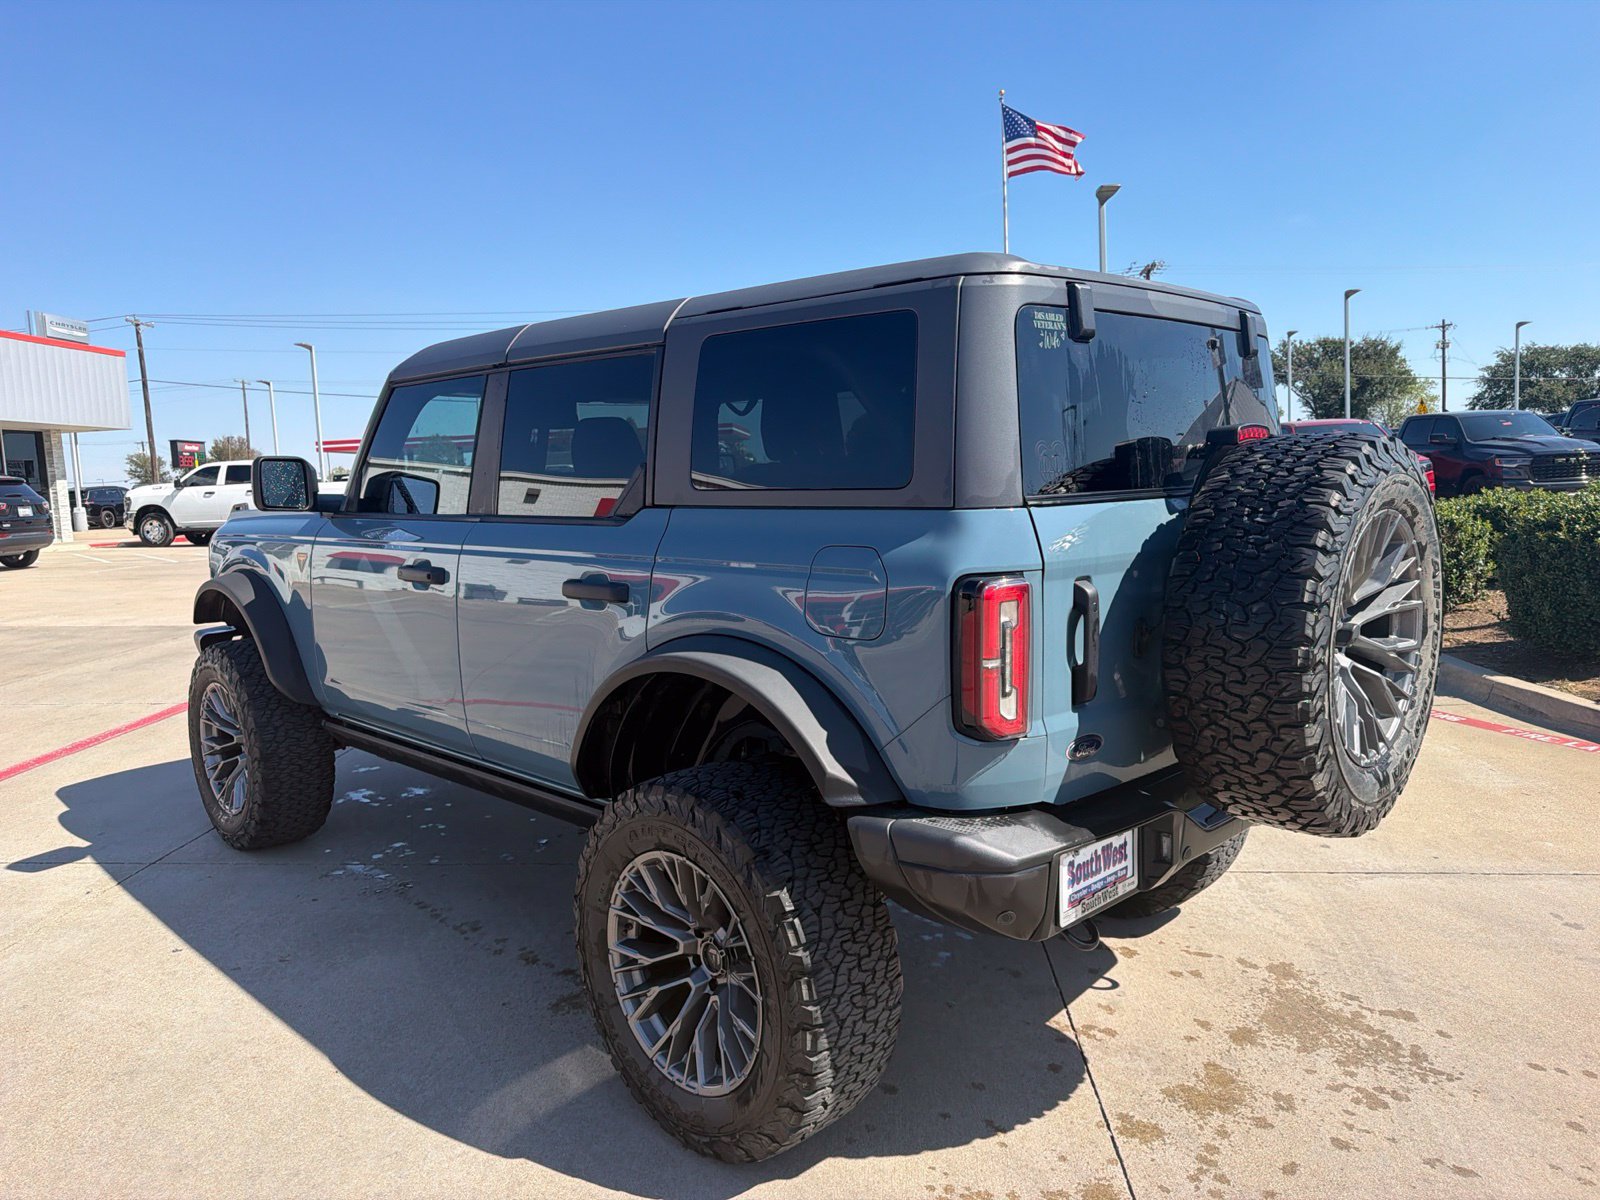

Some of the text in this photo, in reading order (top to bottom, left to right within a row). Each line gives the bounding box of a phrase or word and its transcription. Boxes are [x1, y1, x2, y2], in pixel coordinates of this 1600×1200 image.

[1034, 311, 1064, 321] DISABLED
[49, 320, 87, 332] CHRYSLER
[1501, 728, 1561, 743] FIRE
[1076, 742, 1098, 758] Ford
